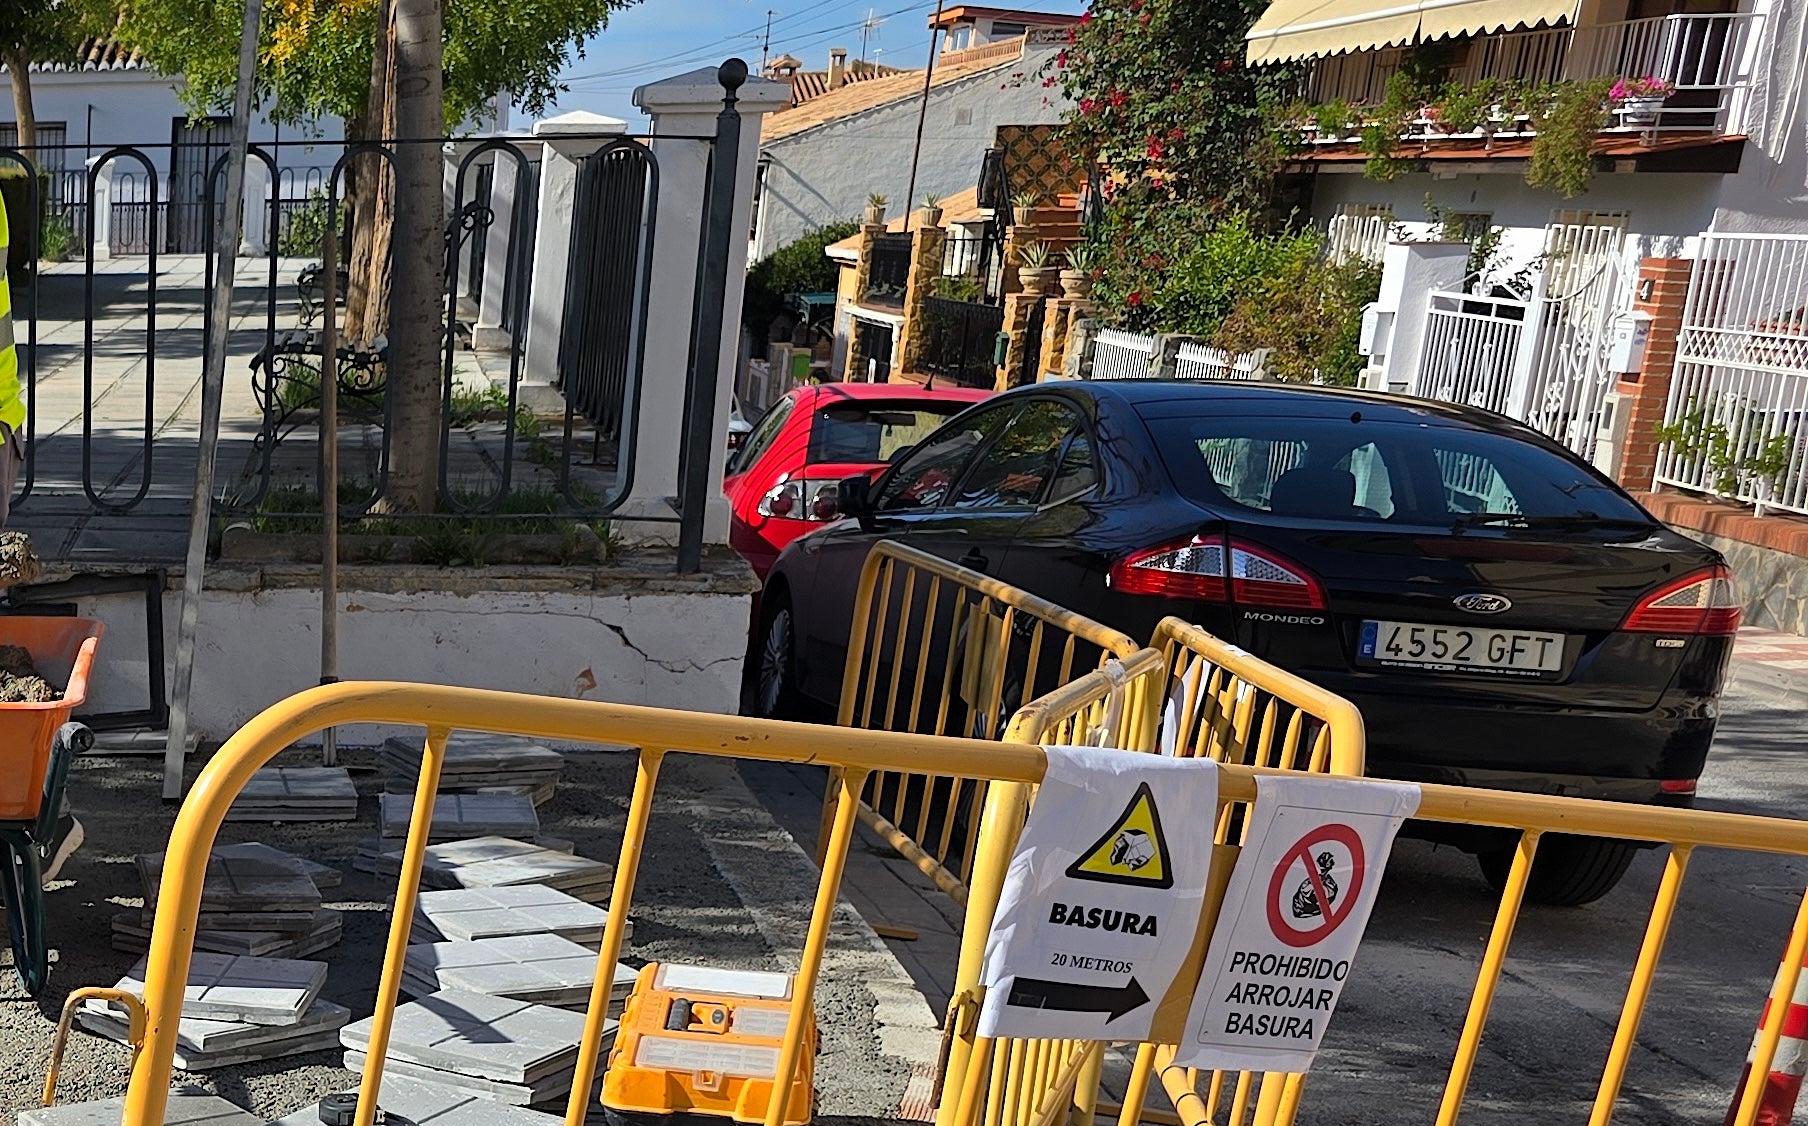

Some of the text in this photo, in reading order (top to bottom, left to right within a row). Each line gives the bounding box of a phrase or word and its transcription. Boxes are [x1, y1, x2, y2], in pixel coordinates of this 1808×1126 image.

[1639, 280, 1651, 300] 4
[1243, 611, 1325, 625] MONDEO
[1363, 626, 1554, 668] E 4552 GFT
[1048, 902, 1157, 937] BASURA
[1050, 952, 1133, 974] 20 METROS
[1228, 951, 1350, 982] PROHIBIDO
[1223, 981, 1334, 1011] ARROJAR
[1223, 1011, 1313, 1040] BASURA
